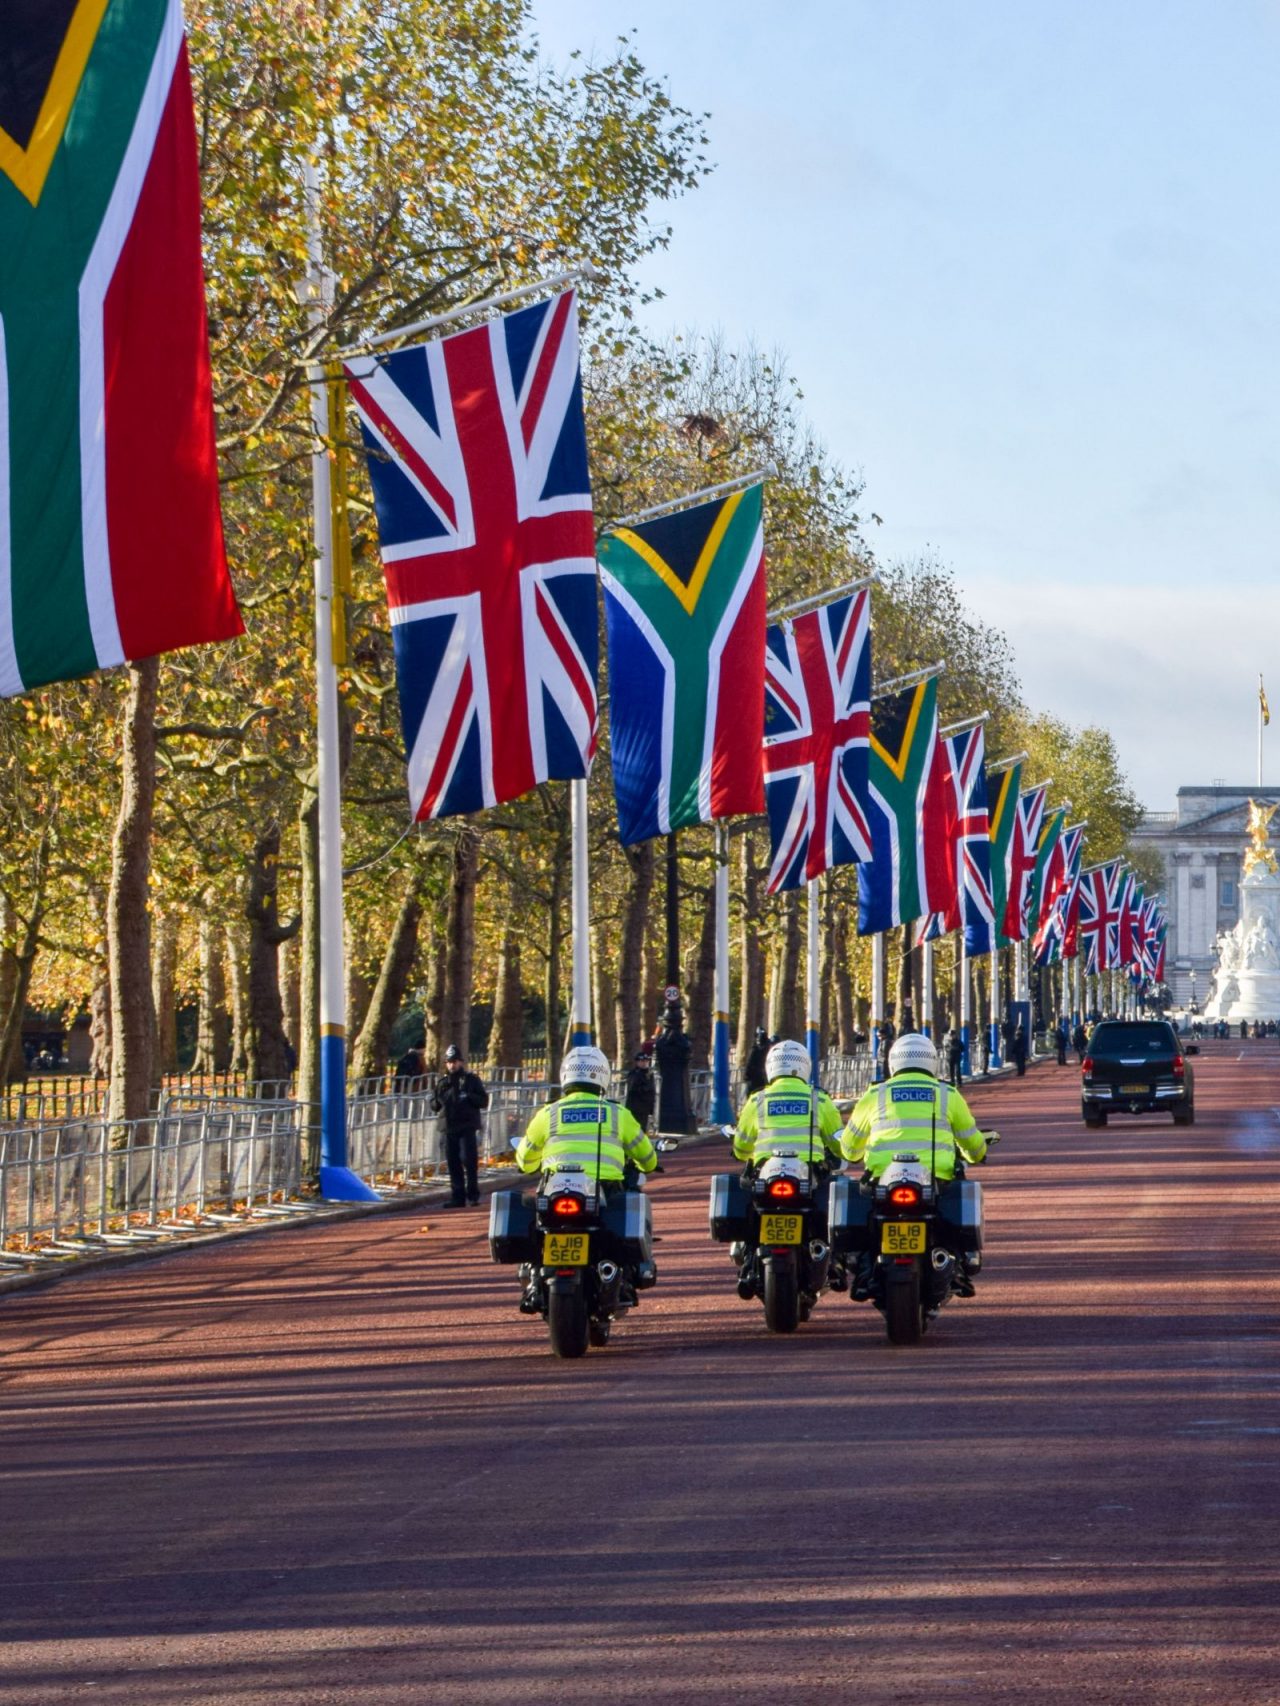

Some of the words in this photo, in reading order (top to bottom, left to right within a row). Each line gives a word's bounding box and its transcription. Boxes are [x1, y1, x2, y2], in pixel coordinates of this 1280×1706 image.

[666, 989, 678, 997] 20
[893, 1092, 935, 1101] POLICE
[769, 1105, 807, 1115] POLICE
[766, 1217, 797, 1228] AE18
[766, 1229, 795, 1241] SEG
[888, 1225, 920, 1237] BL18
[550, 1236, 583, 1248] AJ18
[888, 1238, 919, 1250] SEG
[550, 1250, 581, 1261] SEG
